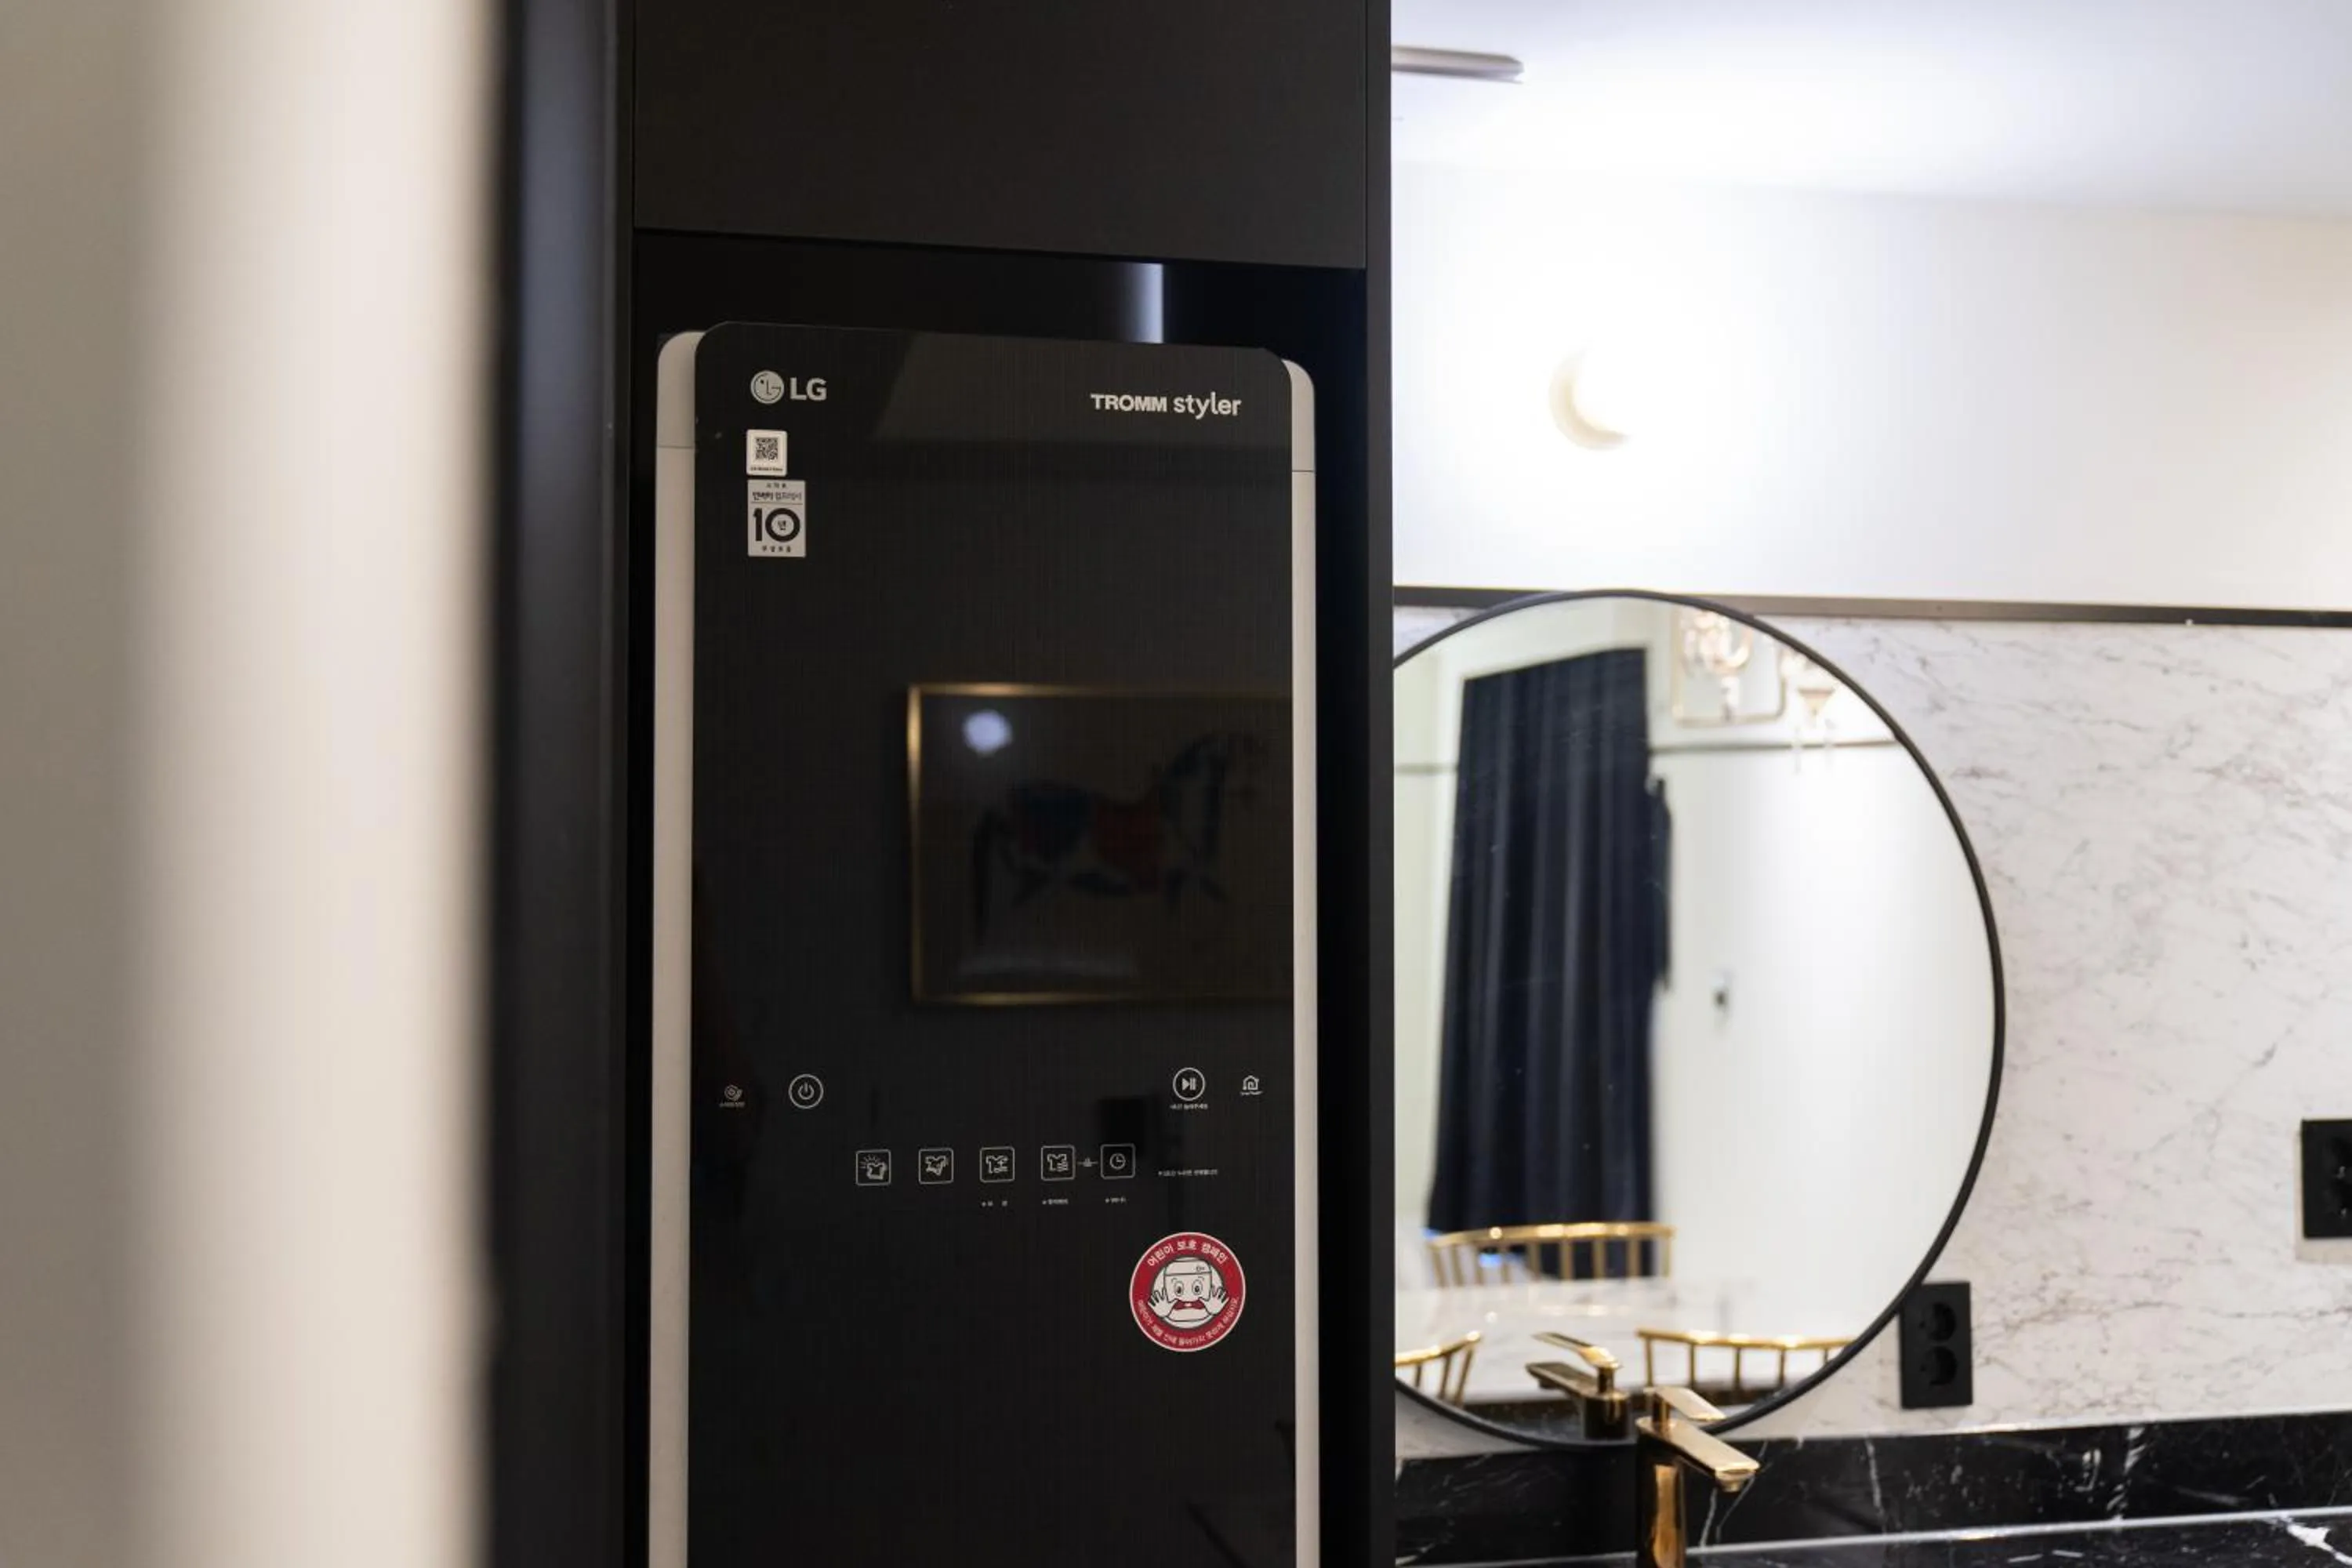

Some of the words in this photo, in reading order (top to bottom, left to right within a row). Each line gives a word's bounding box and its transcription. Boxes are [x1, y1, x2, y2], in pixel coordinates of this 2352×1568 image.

[789, 377, 827, 401] LG
[1091, 394, 1167, 412] TROMM
[1173, 391, 1242, 419] styler
[753, 508, 800, 543] 10
[1147, 1243, 1174, 1266] 어린이
[1177, 1240, 1196, 1250] 보호
